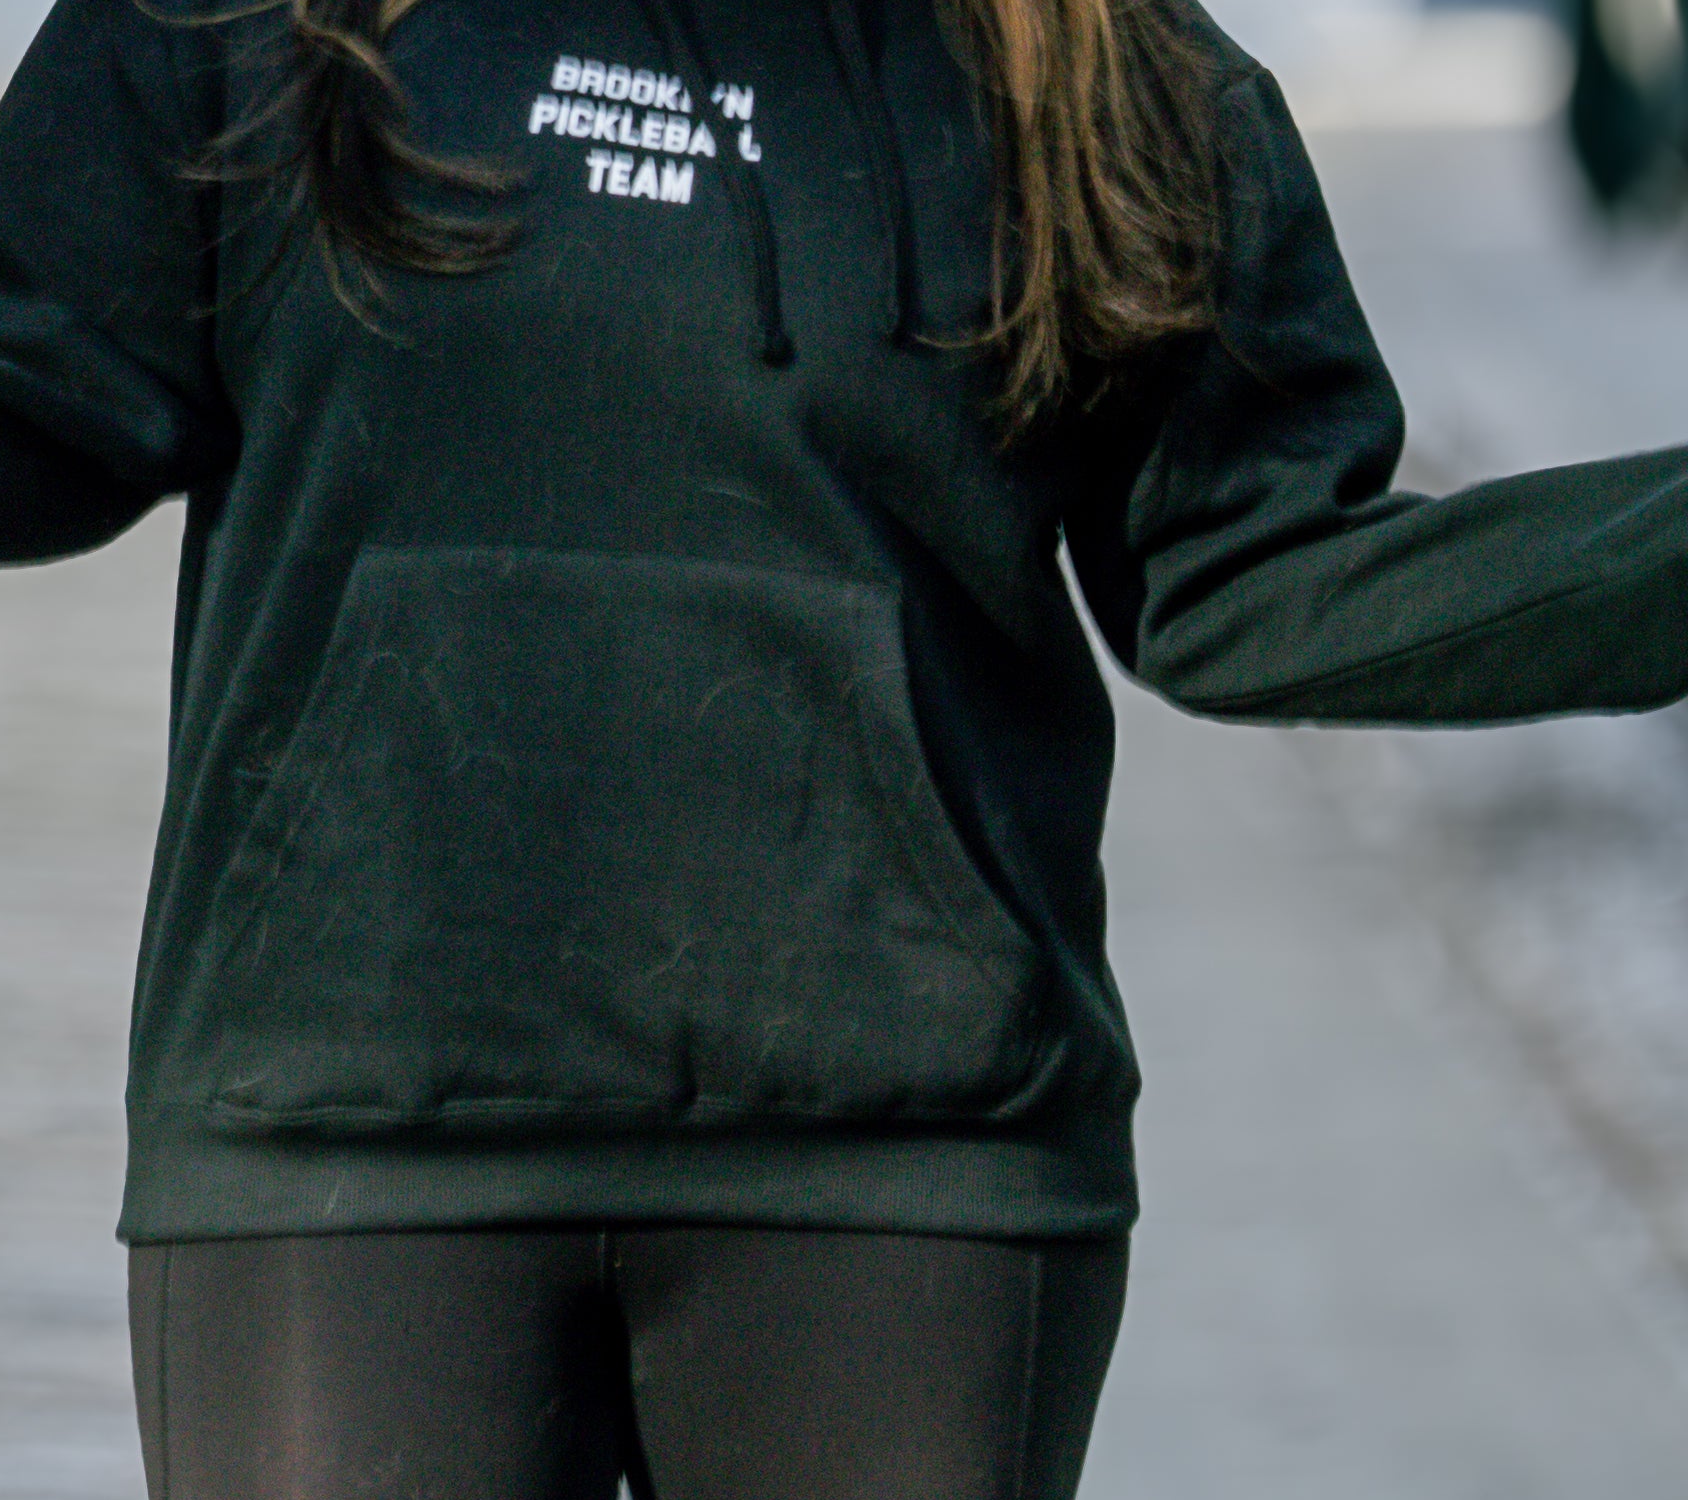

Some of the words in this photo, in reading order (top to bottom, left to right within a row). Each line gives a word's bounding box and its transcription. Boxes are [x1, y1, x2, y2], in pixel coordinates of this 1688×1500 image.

[551, 54, 754, 121] BROOKN
[528, 93, 762, 162] PICKLEBAL
[586, 147, 694, 205] TEAM
